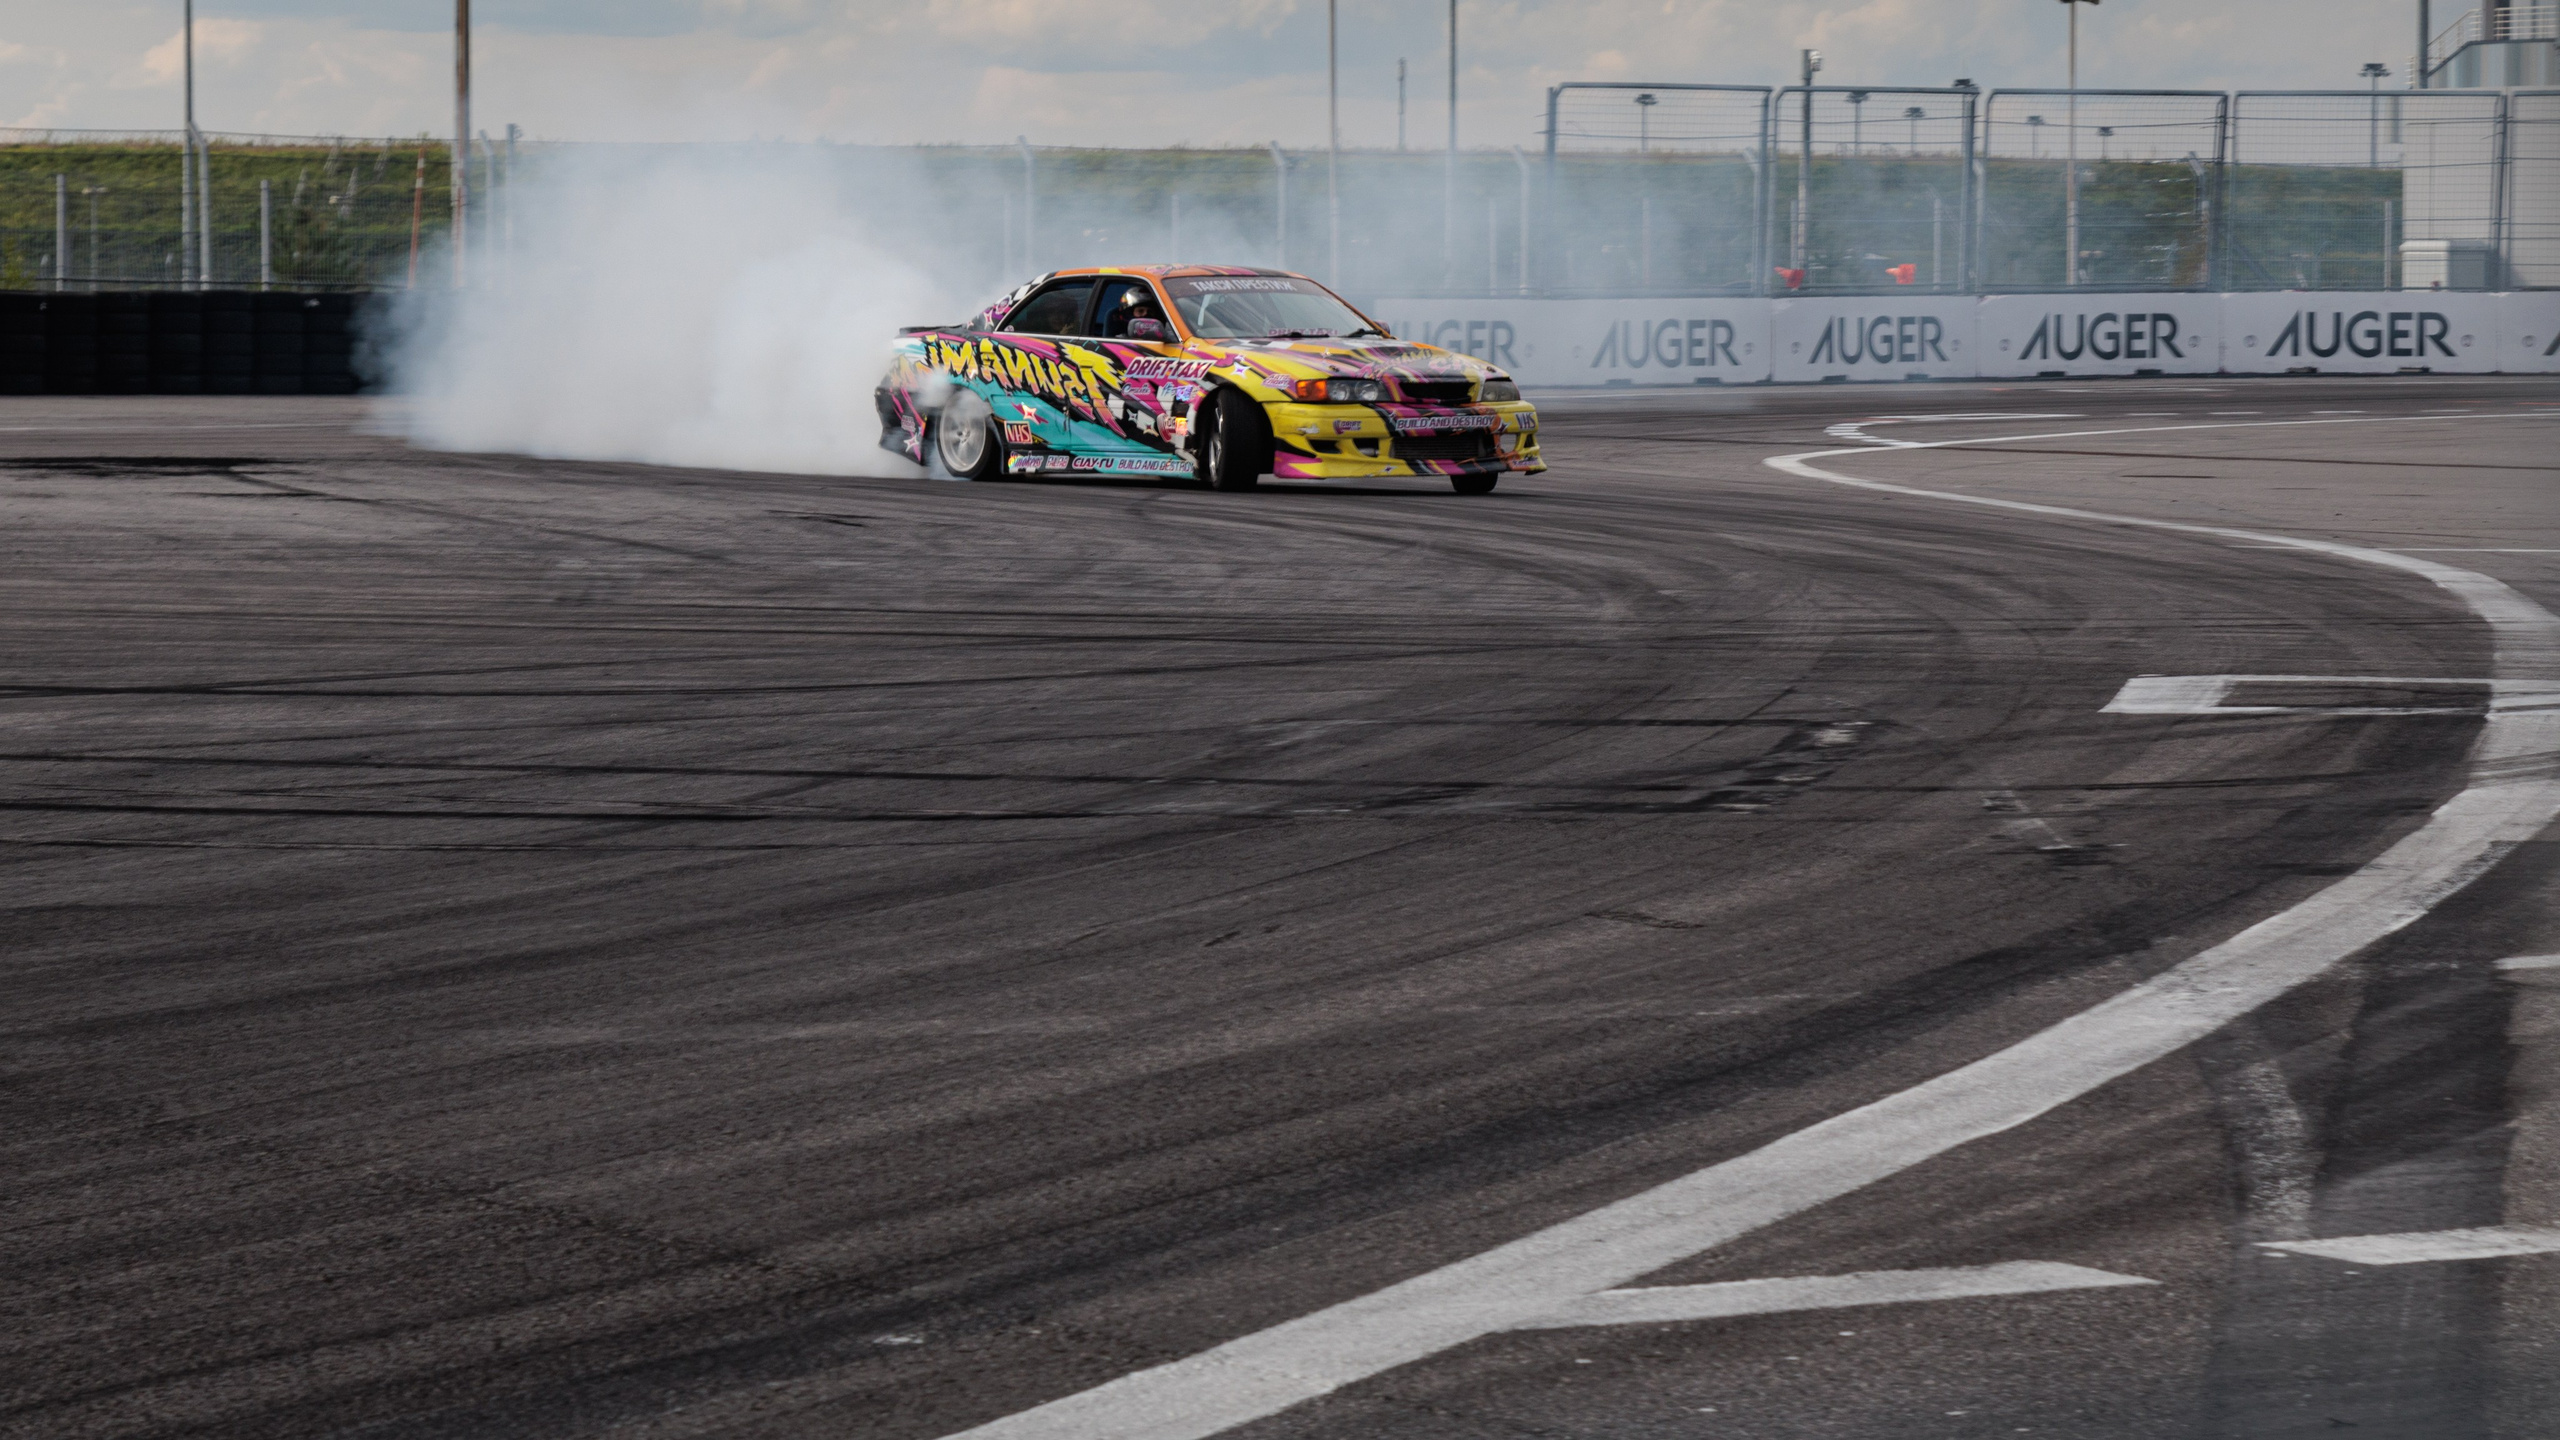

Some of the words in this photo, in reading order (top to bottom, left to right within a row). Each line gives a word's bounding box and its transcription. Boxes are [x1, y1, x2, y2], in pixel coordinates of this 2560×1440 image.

[1190, 281, 1233, 292] ТАКСИ
[1232, 279, 1298, 291] ПРЕСТИЖ
[1808, 315, 1948, 365] AUGER
[2017, 312, 2186, 361] AUGER
[2265, 309, 2457, 358] AUGER
[1591, 319, 1739, 369] AUGER
[1397, 418, 1427, 429] BUILD
[1429, 417, 1451, 428] AND
[1452, 415, 1495, 427] DESTROY
[1515, 412, 1536, 429] VHS
[1007, 423, 1031, 443] VHS
[1118, 458, 1142, 469] BUILD
[1141, 459, 1160, 470] AND
